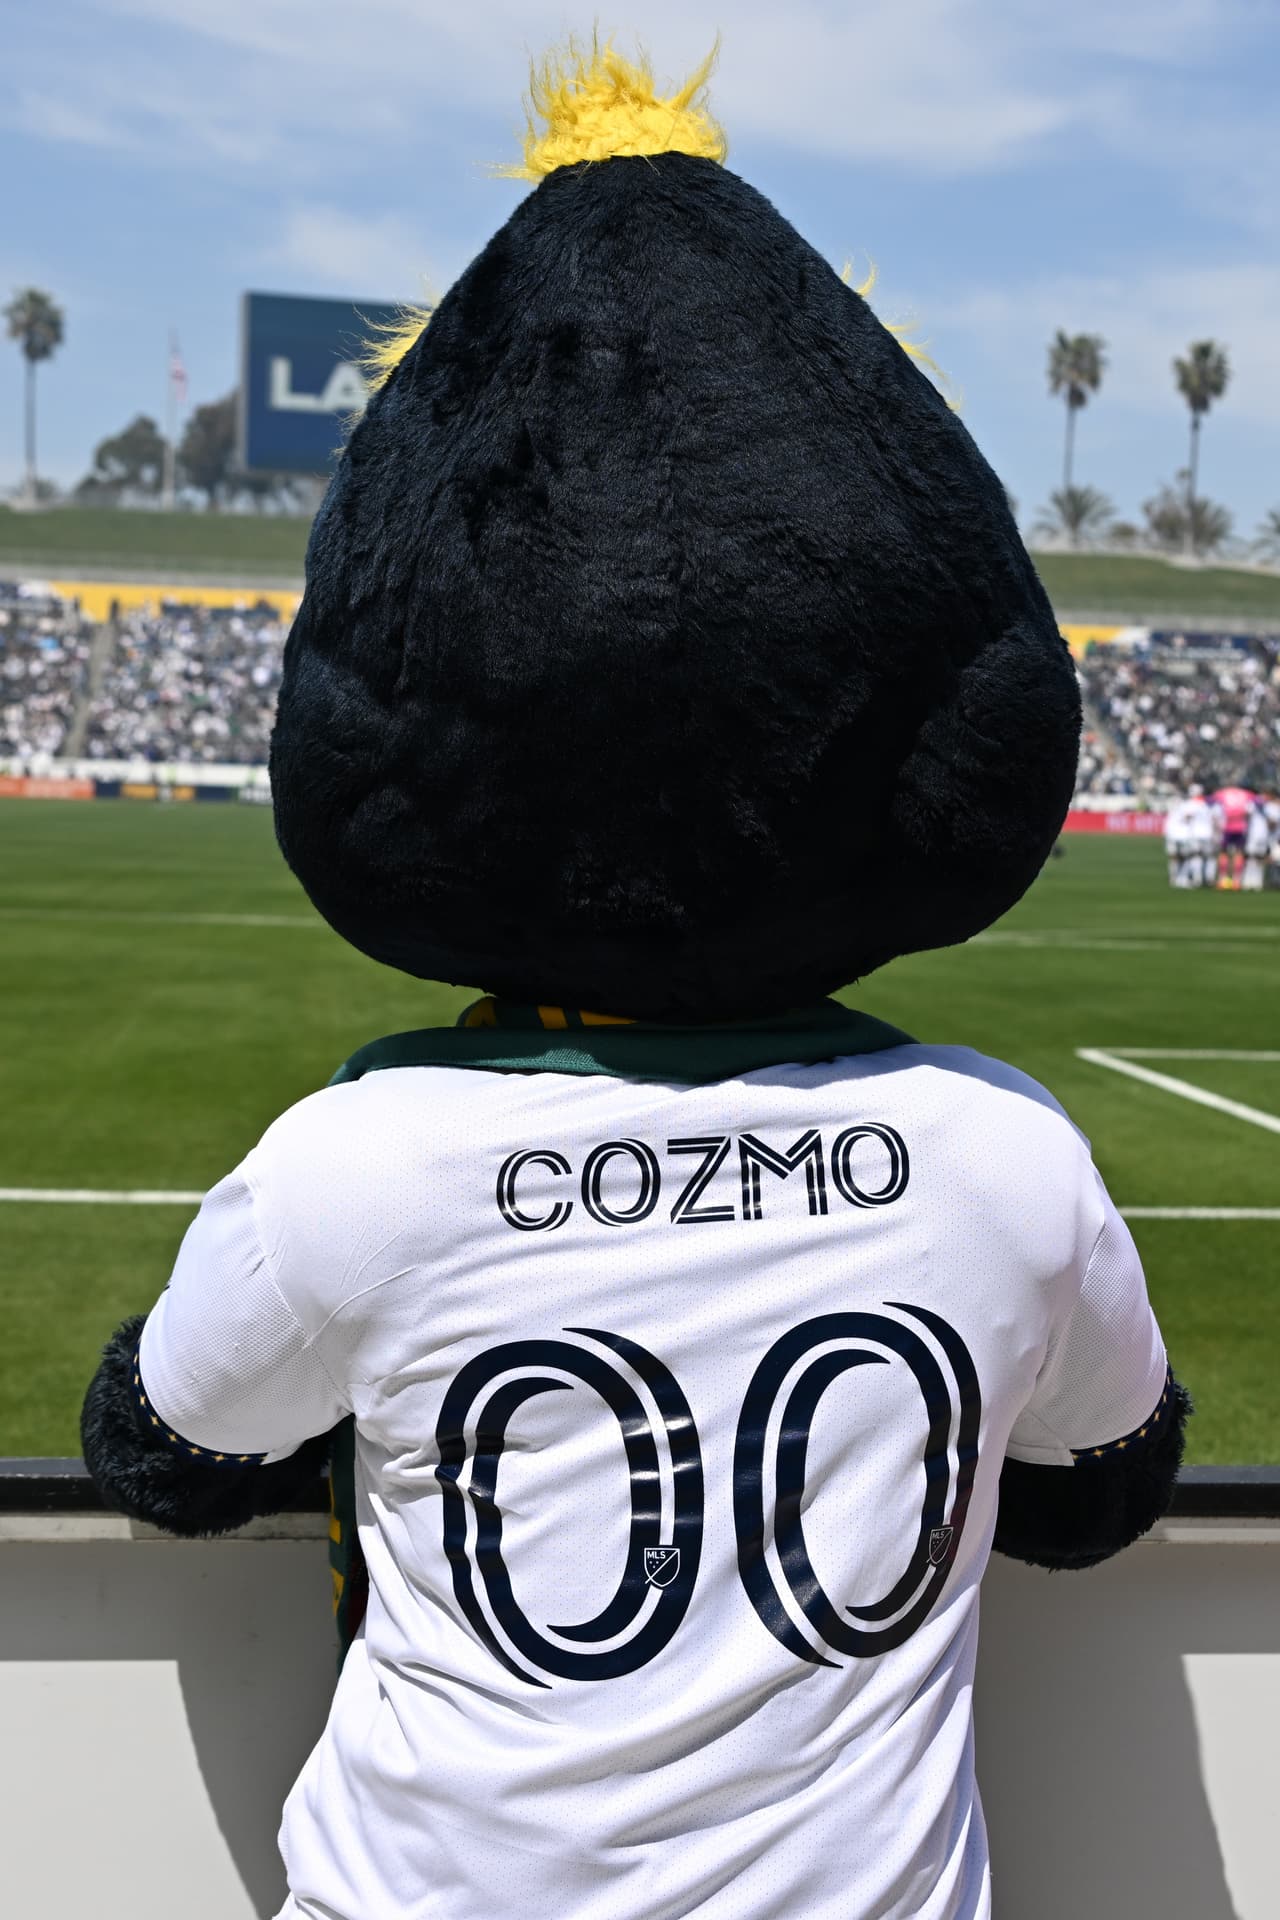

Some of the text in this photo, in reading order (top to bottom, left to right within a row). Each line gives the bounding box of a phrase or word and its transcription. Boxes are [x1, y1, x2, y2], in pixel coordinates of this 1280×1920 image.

[270, 357, 368, 412] LA
[496, 1122, 910, 1232] COZMO
[434, 1301, 982, 1689] 00
[646, 1550, 666, 1560] MLS
[932, 1531, 945, 1539] MLS
